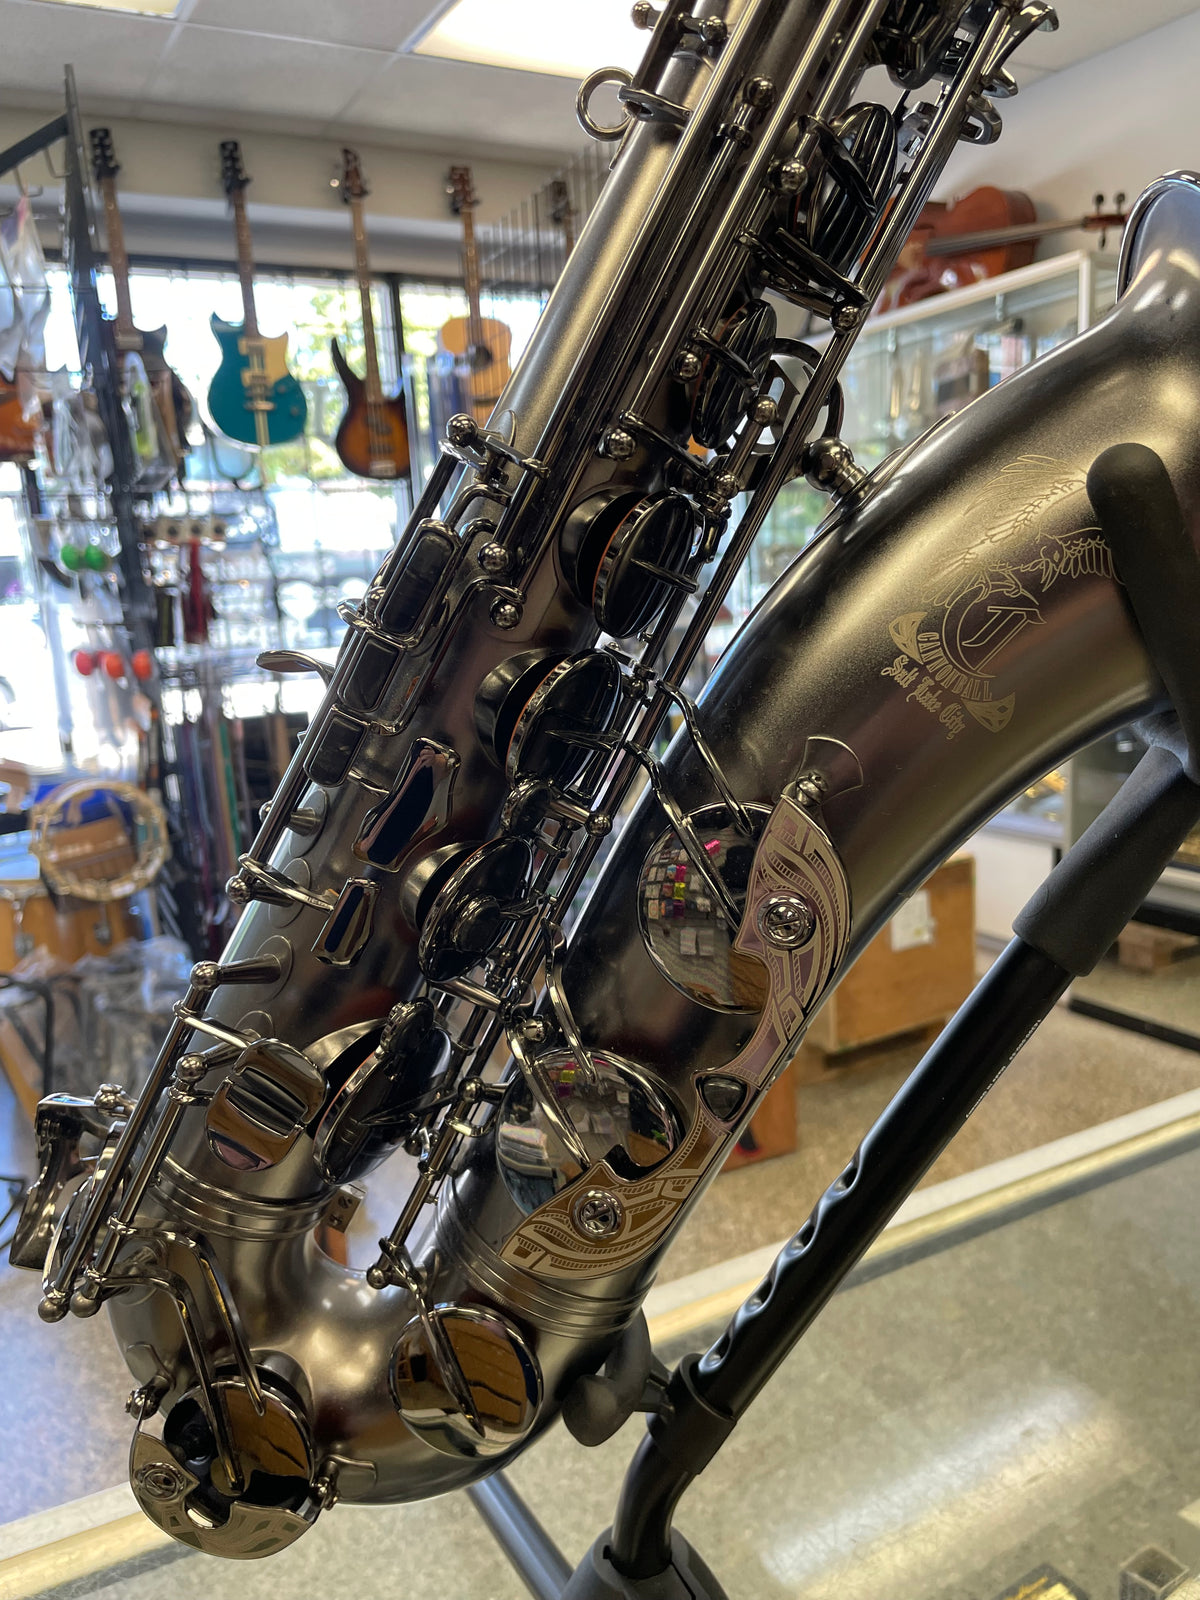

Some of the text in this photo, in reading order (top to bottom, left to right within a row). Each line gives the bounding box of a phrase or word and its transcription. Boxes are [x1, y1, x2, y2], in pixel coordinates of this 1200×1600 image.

[880, 654, 966, 740] Salt Lake City
[917, 632, 992, 701] CANNONBALL
